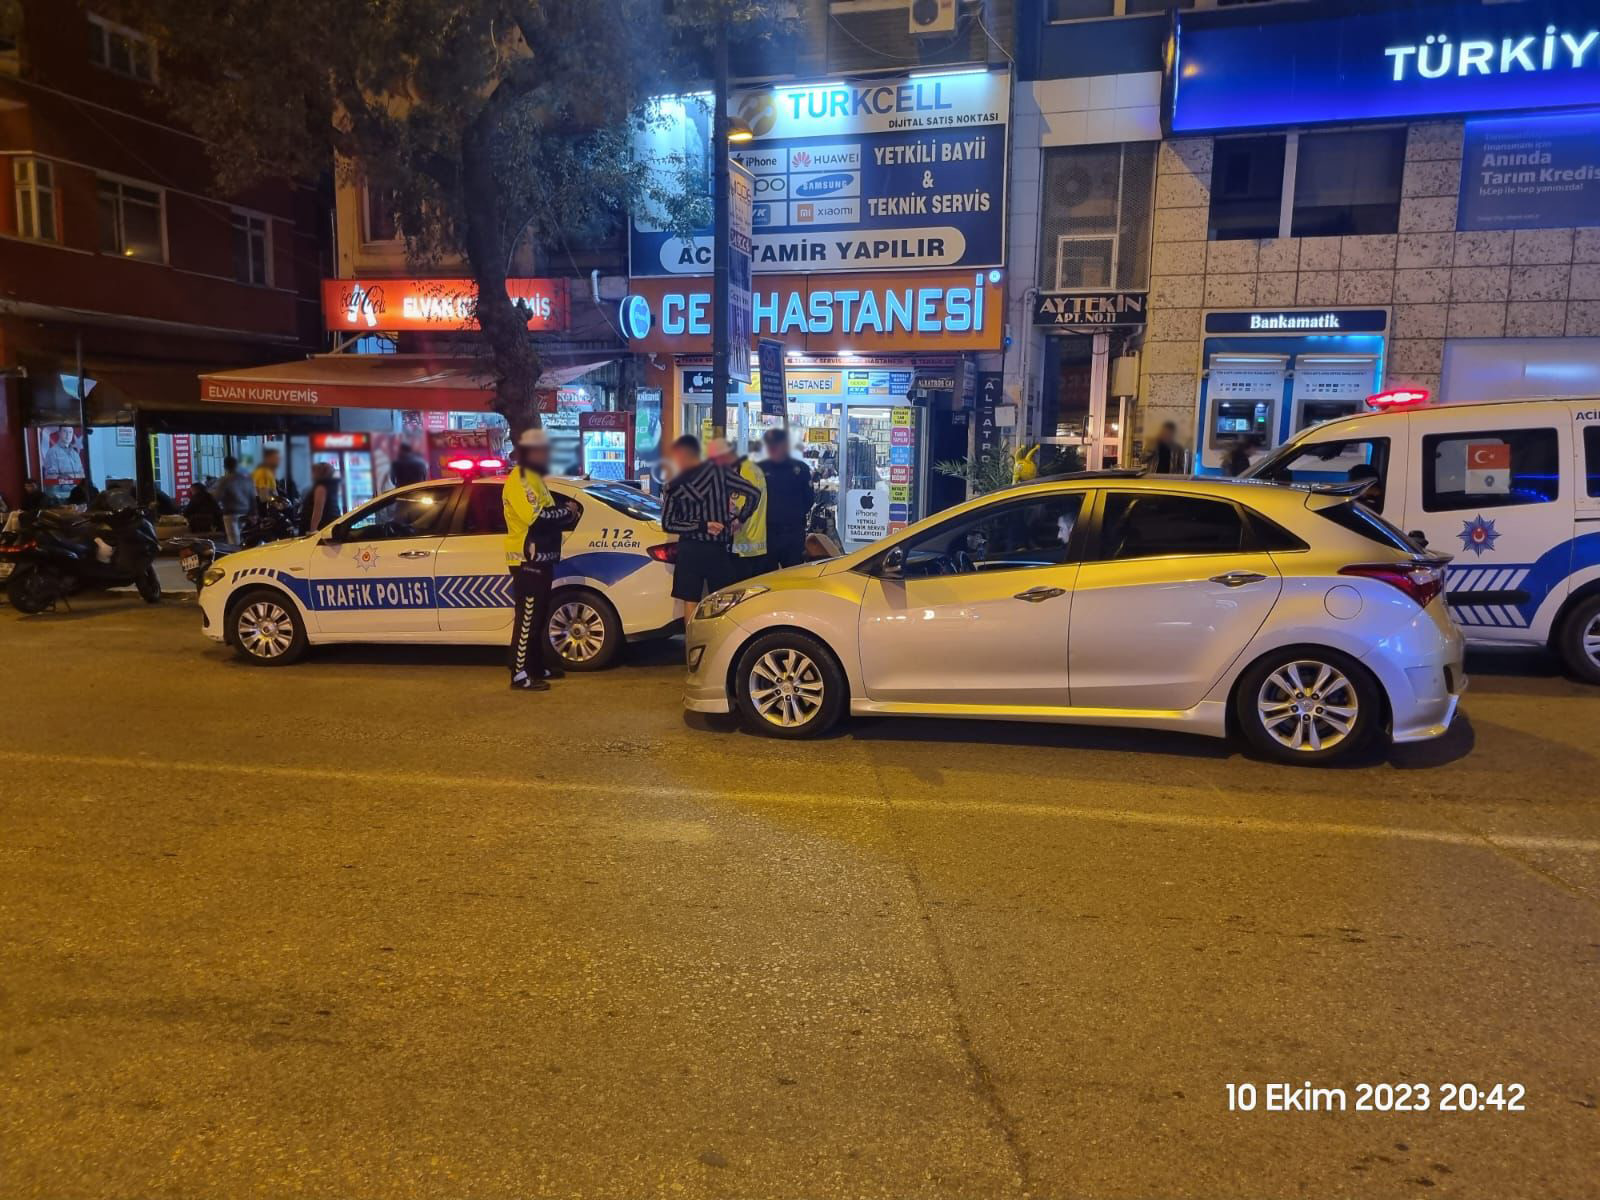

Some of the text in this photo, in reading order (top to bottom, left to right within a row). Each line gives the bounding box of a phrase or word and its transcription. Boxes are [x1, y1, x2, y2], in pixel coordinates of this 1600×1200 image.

[787, 82, 953, 120] TURKCELL
[888, 112, 999, 129] DİJİTAL SATIŞ NOKTASI
[813, 153, 859, 165] HUAWEI
[874, 136, 986, 166] YETKİLİ BAYİİ
[1482, 150, 1552, 168] Anında
[745, 156, 777, 169] iPhone
[802, 180, 848, 191] SAMSUNG
[922, 170, 935, 189] &
[1481, 170, 1536, 185] Tarım
[867, 188, 991, 217] TEKNİK SERVİS
[817, 207, 853, 217] xiaomi
[677, 246, 712, 266] AC
[836, 237, 946, 260] YAPILIR
[403, 296, 454, 319] ELVAN
[752, 272, 985, 335] HASTANESİ
[1249, 313, 1340, 330] Bankamatik
[787, 376, 833, 391] HASTANESİ
[208, 386, 319, 405] ELVAN KURUYEMİŞ
[1575, 408, 1600, 421] ACİ
[855, 509, 879, 518] iPhone
[600, 527, 635, 540] 112
[588, 539, 641, 549] ACİL ÇAĞRI
[316, 581, 430, 607] TRAFİK POLİSİ
